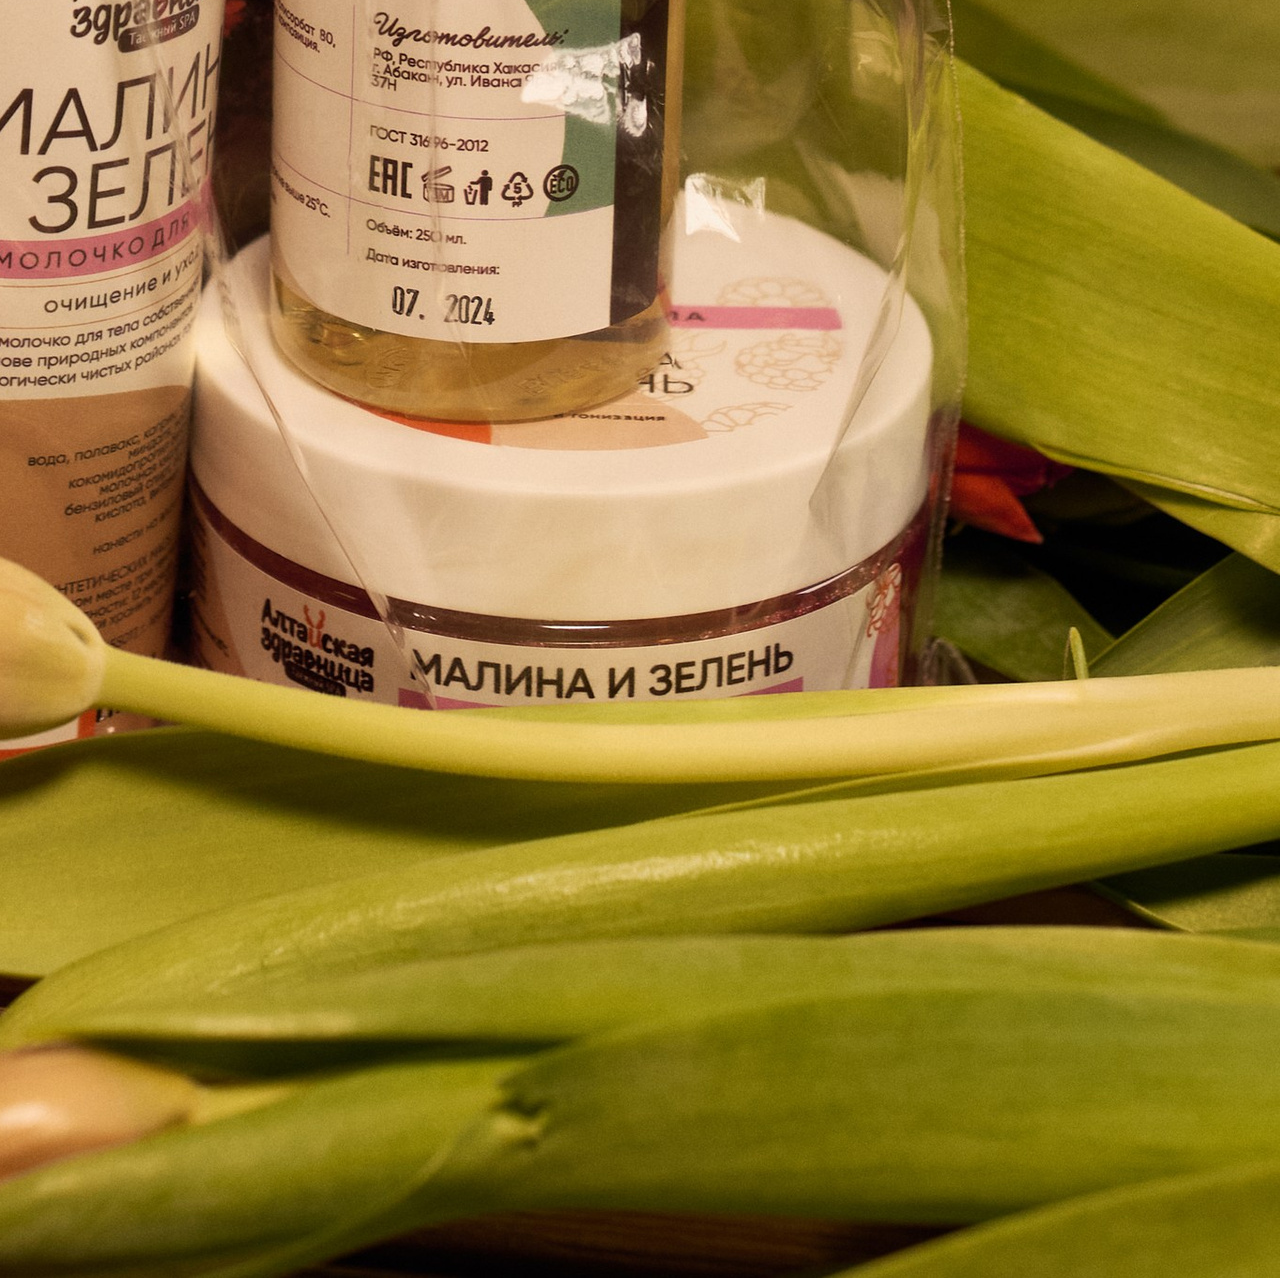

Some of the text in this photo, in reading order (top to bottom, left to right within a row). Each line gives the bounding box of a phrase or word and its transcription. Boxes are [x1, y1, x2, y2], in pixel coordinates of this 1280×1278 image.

[373, 12, 569, 49] Изготовитель:
[373, 46, 396, 66] РФ,
[398, 52, 490, 75] Республика
[445, 75, 467, 89] ул.
[369, 124, 408, 144] ГОСТ
[151, 210, 191, 249] ДЛЯ
[365, 218, 413, 240] Объём:
[445, 234, 468, 245] мл.
[365, 247, 500, 276] Дата изготовления:
[43, 277, 158, 314] очищение
[161, 269, 172, 286] и
[391, 285, 496, 326] 07. 2024
[74, 329, 103, 347] для
[106, 320, 139, 339] тела
[36, 343, 127, 369] природных
[81, 359, 132, 381] чистых
[27, 453, 70, 467] вода,
[261, 597, 375, 669] Алтайская
[260, 626, 375, 693] здравница
[409, 648, 596, 700] МАЛИНА
[607, 667, 636, 700] И
[648, 642, 795, 697] ЗЕЛЕНЬ
